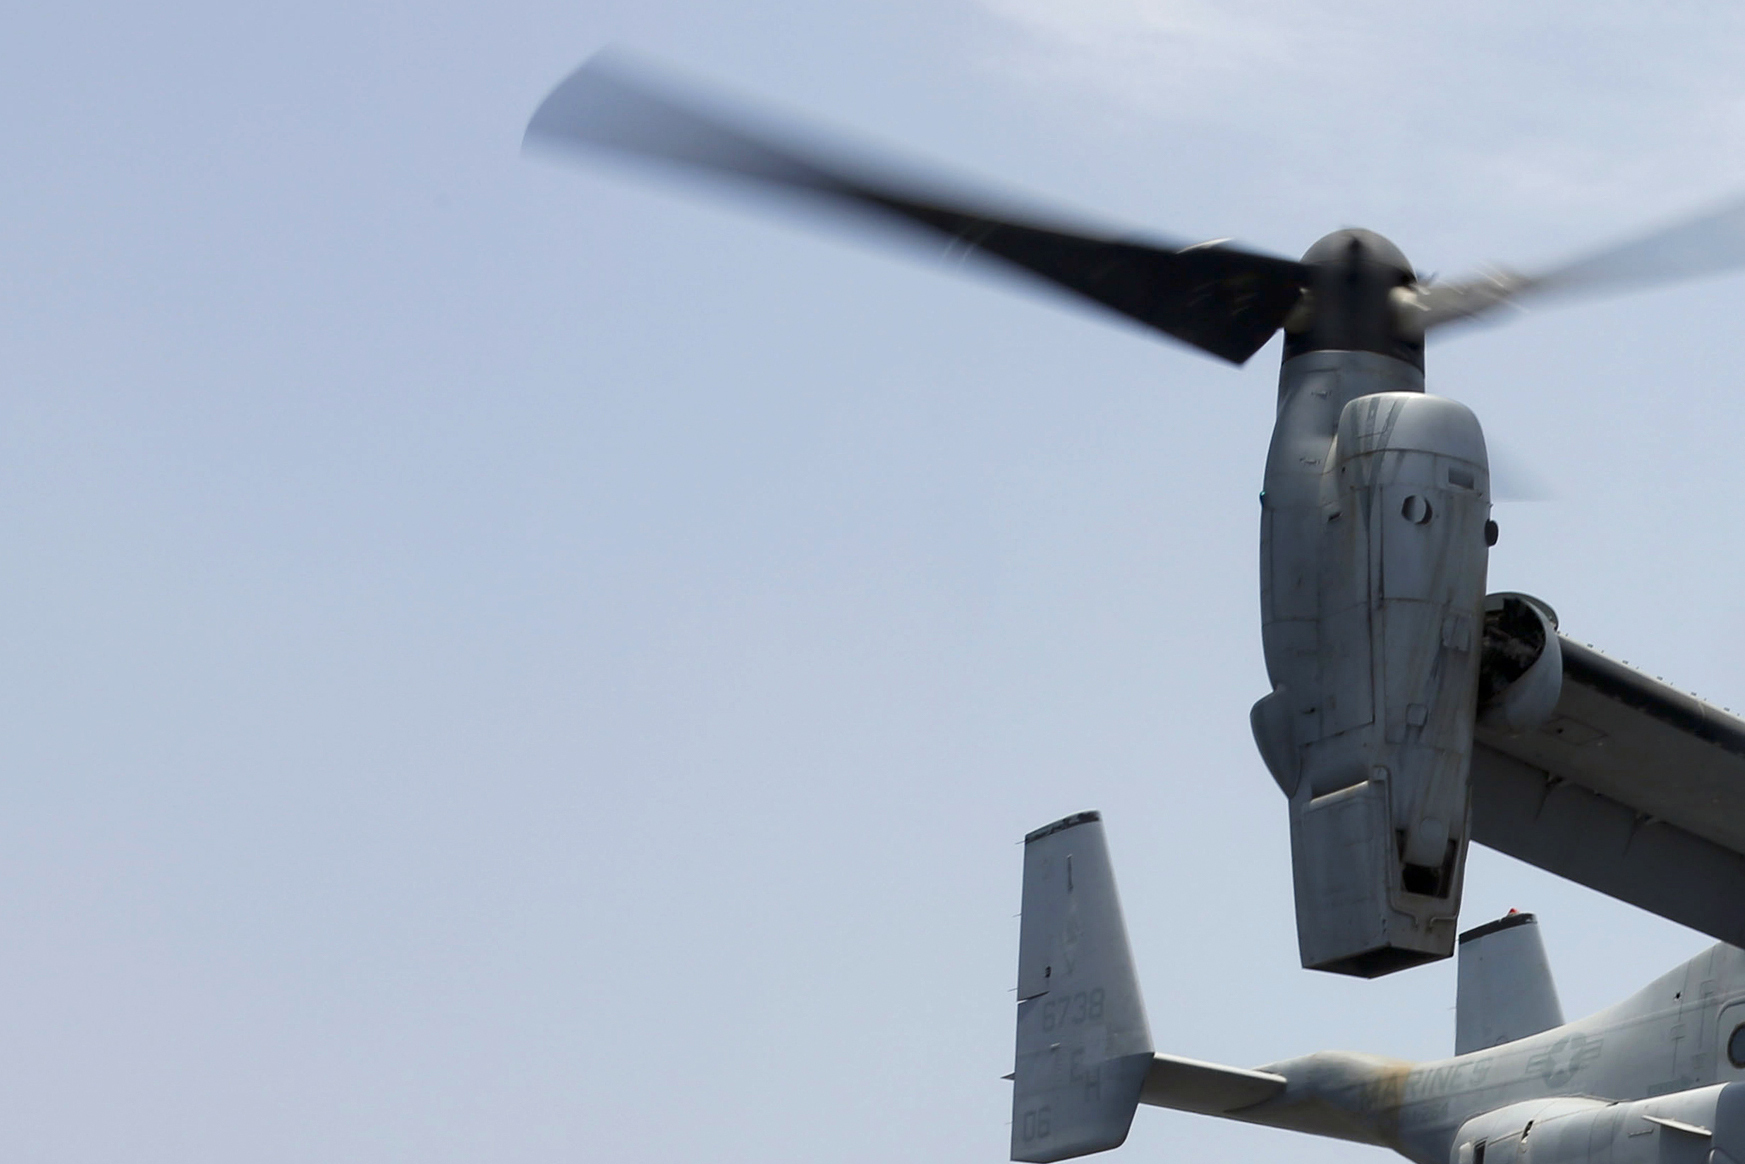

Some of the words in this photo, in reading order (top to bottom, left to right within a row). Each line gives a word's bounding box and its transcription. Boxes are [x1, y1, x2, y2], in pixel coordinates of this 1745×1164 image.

[1043, 987, 1105, 1032] 6738
[1359, 1057, 1494, 1107] MARINES
[1023, 1104, 1052, 1142] 06
